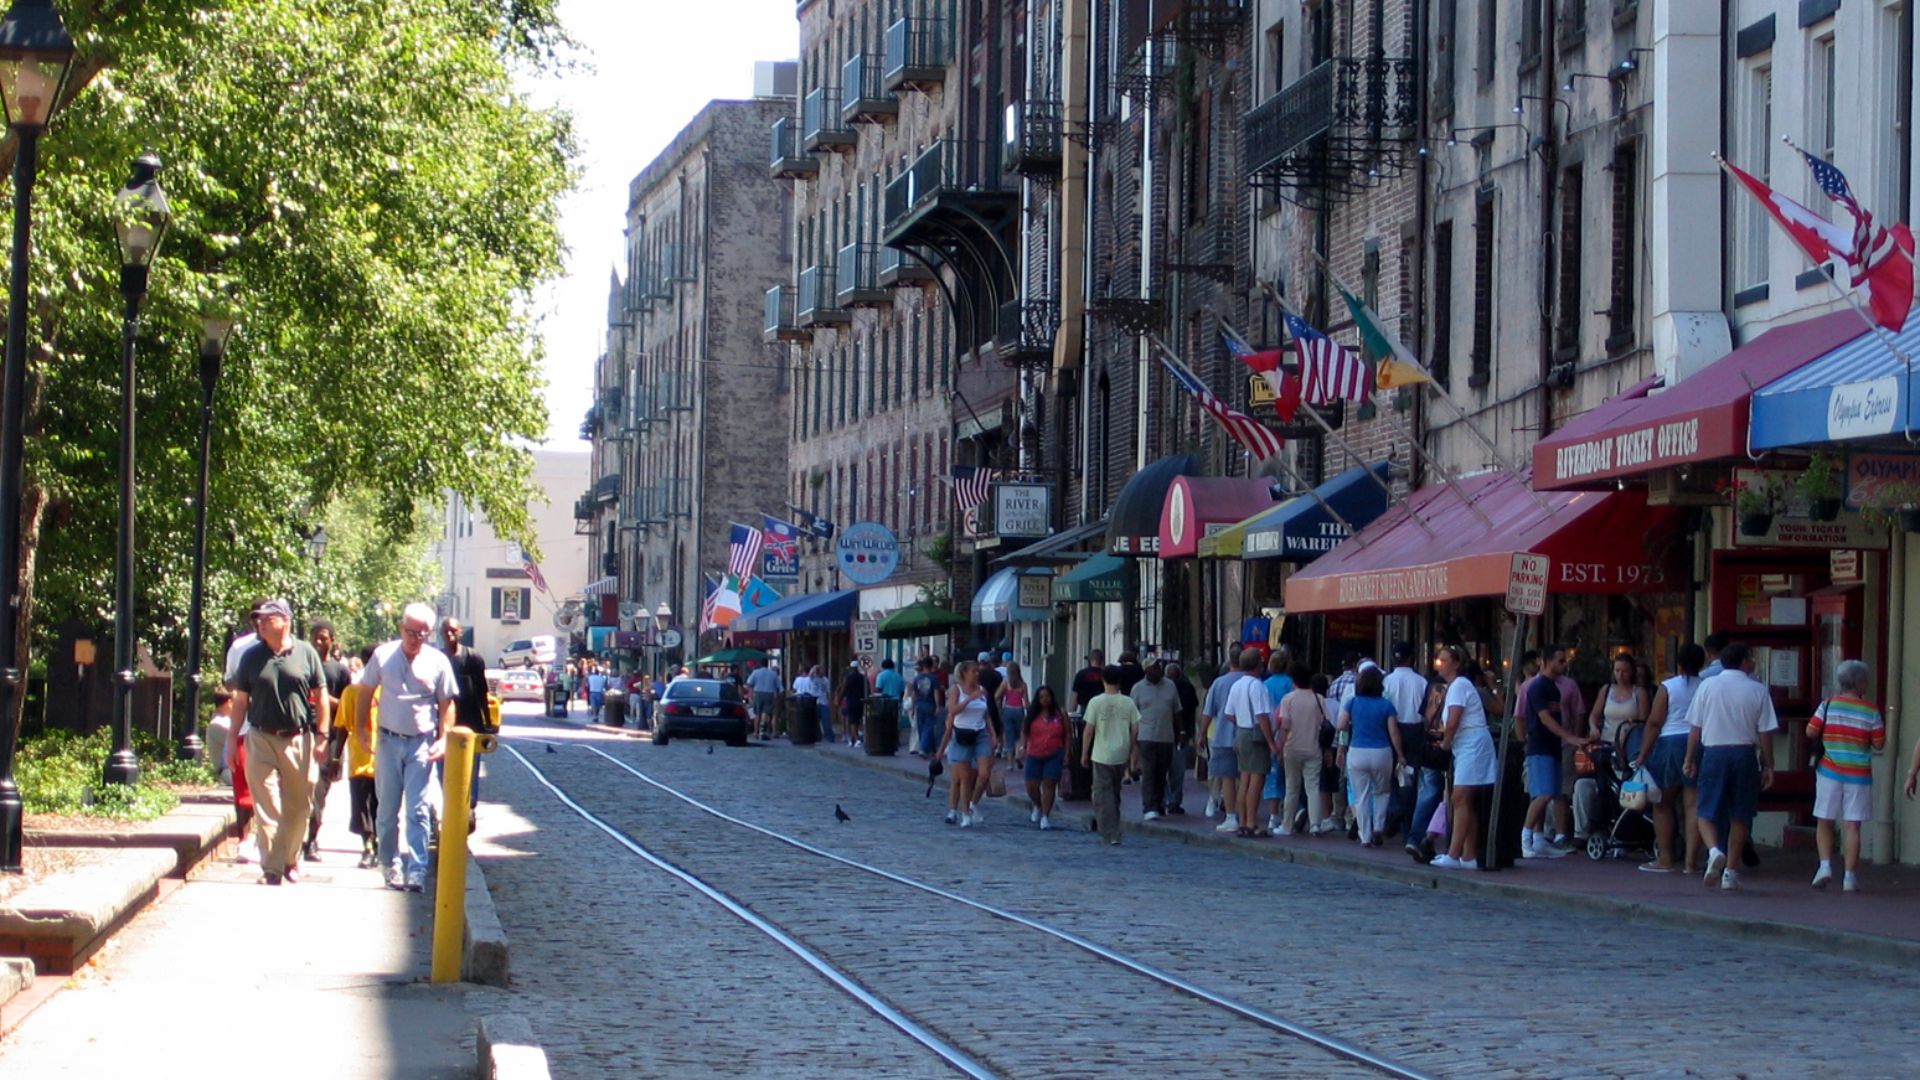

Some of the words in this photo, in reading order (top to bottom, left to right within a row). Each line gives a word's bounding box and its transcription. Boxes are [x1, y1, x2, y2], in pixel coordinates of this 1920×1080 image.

[1556, 437, 1613, 480] RIVERBOAT
[1616, 427, 1654, 468] TICKET
[1657, 417, 1699, 459] OFFICE
[1856, 459, 1920, 480] OLYMPI
[1014, 489, 1030, 497] THE
[1005, 499, 1040, 510] RIVER
[1005, 519, 1040, 530] GRILL
[1318, 522, 1353, 536] THE
[1778, 524, 1807, 533] YOUR
[1810, 525, 1847, 534] TICKET
[1777, 534, 1847, 543] INFORMATION
[1521, 559, 1537, 571] NO
[1511, 571, 1544, 586] PARKING
[1560, 562, 1607, 583] EST.
[1511, 586, 1524, 595] THIS
[1527, 587, 1542, 598] SIDE
[1519, 598, 1541, 608] STREET
[857, 638, 874, 651] 15
